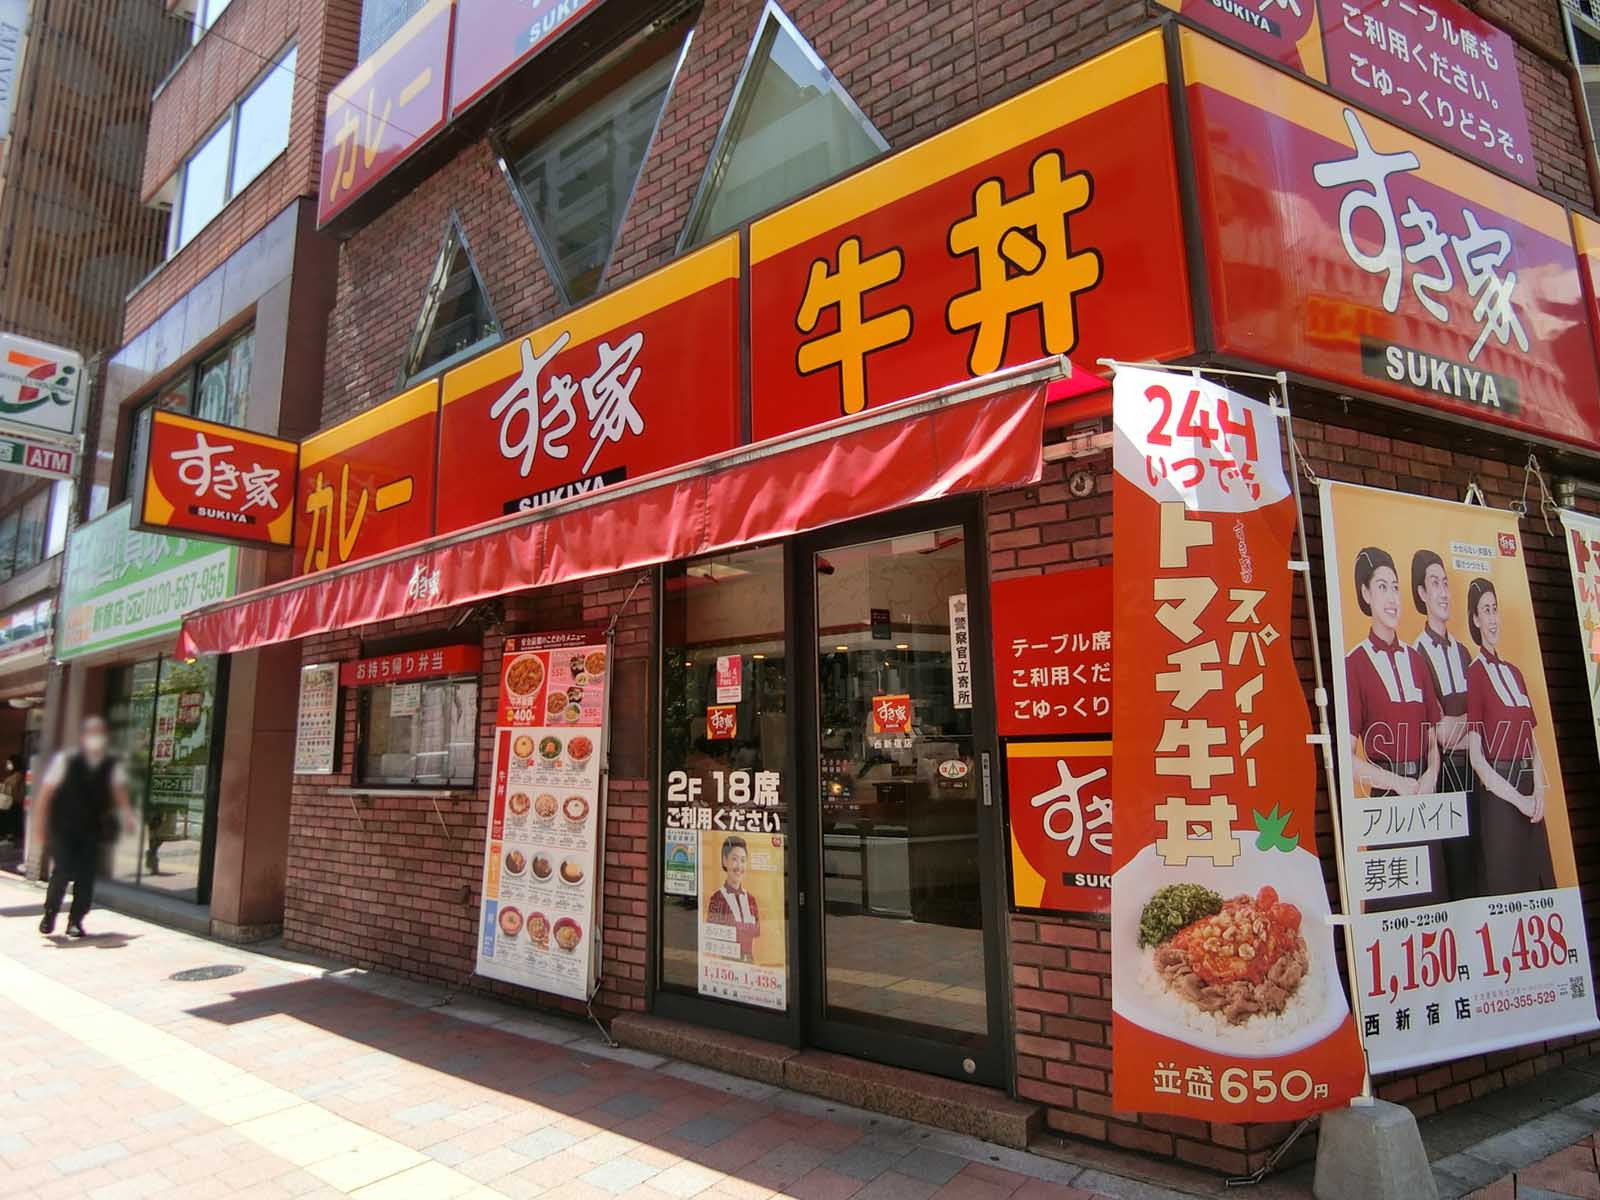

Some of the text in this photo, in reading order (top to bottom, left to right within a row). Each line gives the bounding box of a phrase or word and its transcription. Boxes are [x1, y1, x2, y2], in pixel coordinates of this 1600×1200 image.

[1341, 2, 1499, 110] ご利用ください。
[1349, 52, 1525, 164] ごゆっくりどうぞ。
[329, 66, 433, 203] カレー
[1313, 107, 1530, 362] すき家
[795, 148, 1104, 415] 牛丼
[1385, 345, 1502, 408] SUKIYA
[489, 330, 646, 478] すき家
[30, 448, 68, 471] ATM
[170, 433, 281, 512] すき家
[197, 506, 249, 524] SUKIYA
[303, 463, 414, 575] カレー
[356, 651, 444, 680] お持ち帰り弁当
[953, 616, 971, 705] 警察官立寄所
[1011, 630, 1112, 658] テーブル席
[1011, 662, 1112, 688] ご利用くだ
[1153, 500, 1242, 868] トマチ牛丼
[1225, 587, 1282, 788] スパイシー
[1013, 696, 1110, 721] ごゆっくり
[667, 770, 702, 802] 2F
[713, 769, 782, 807] 18席
[665, 806, 782, 832] ご利用ください
[1362, 801, 1463, 837] アルバイト
[1364, 855, 1421, 893] 募集!
[1364, 997, 1472, 1038] 西新宿店
[1483, 990, 1557, 1014] 0120-355-529
